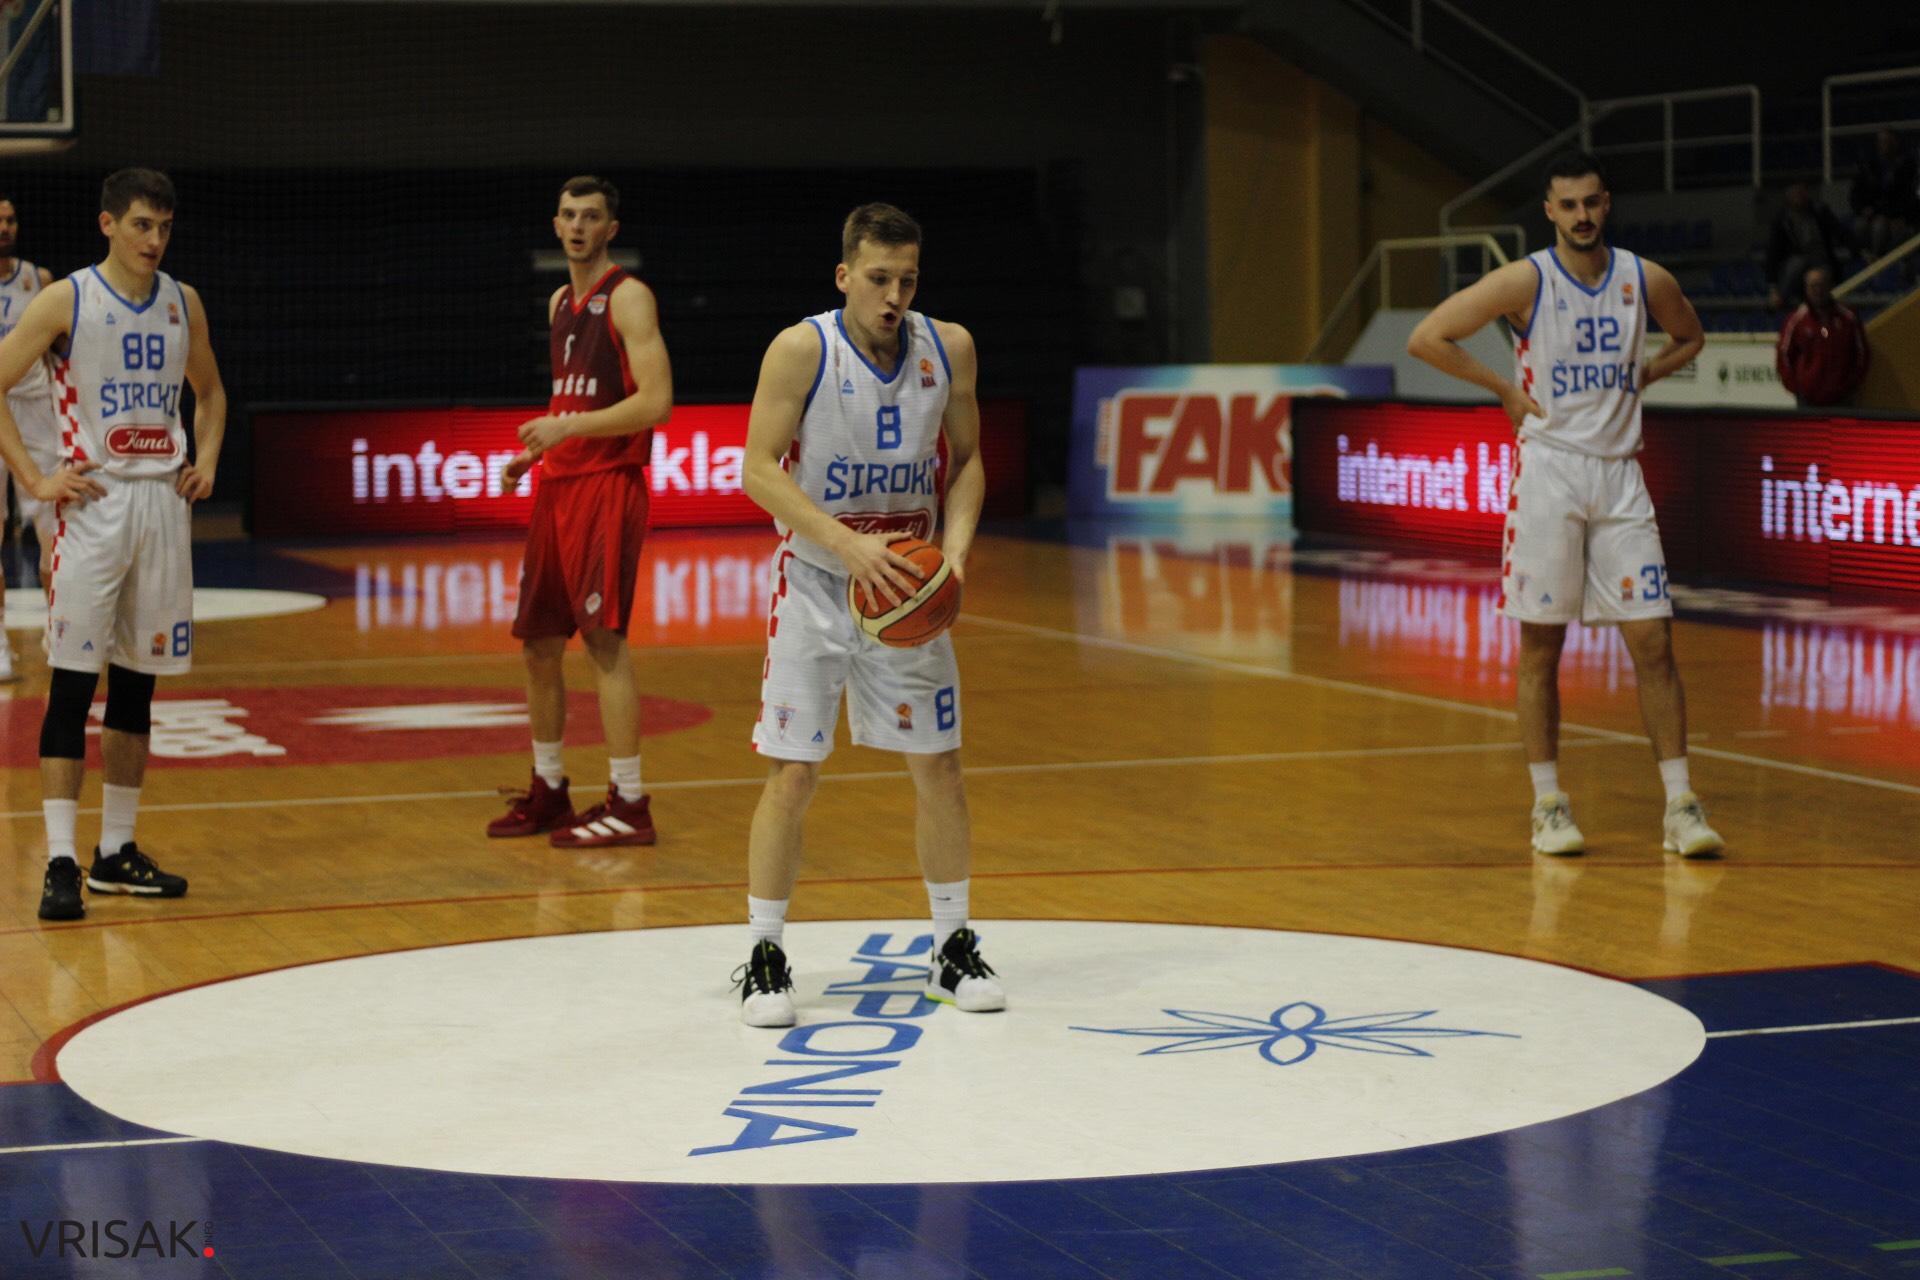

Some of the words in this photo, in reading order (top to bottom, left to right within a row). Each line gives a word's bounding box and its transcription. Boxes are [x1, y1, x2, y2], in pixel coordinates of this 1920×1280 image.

[122, 333, 166, 371] 88
[1575, 316, 1621, 354] 32
[876, 405, 903, 450] 8
[1114, 394, 1293, 493] FAK
[1337, 434, 1469, 511] internet
[934, 686, 956, 732] 8
